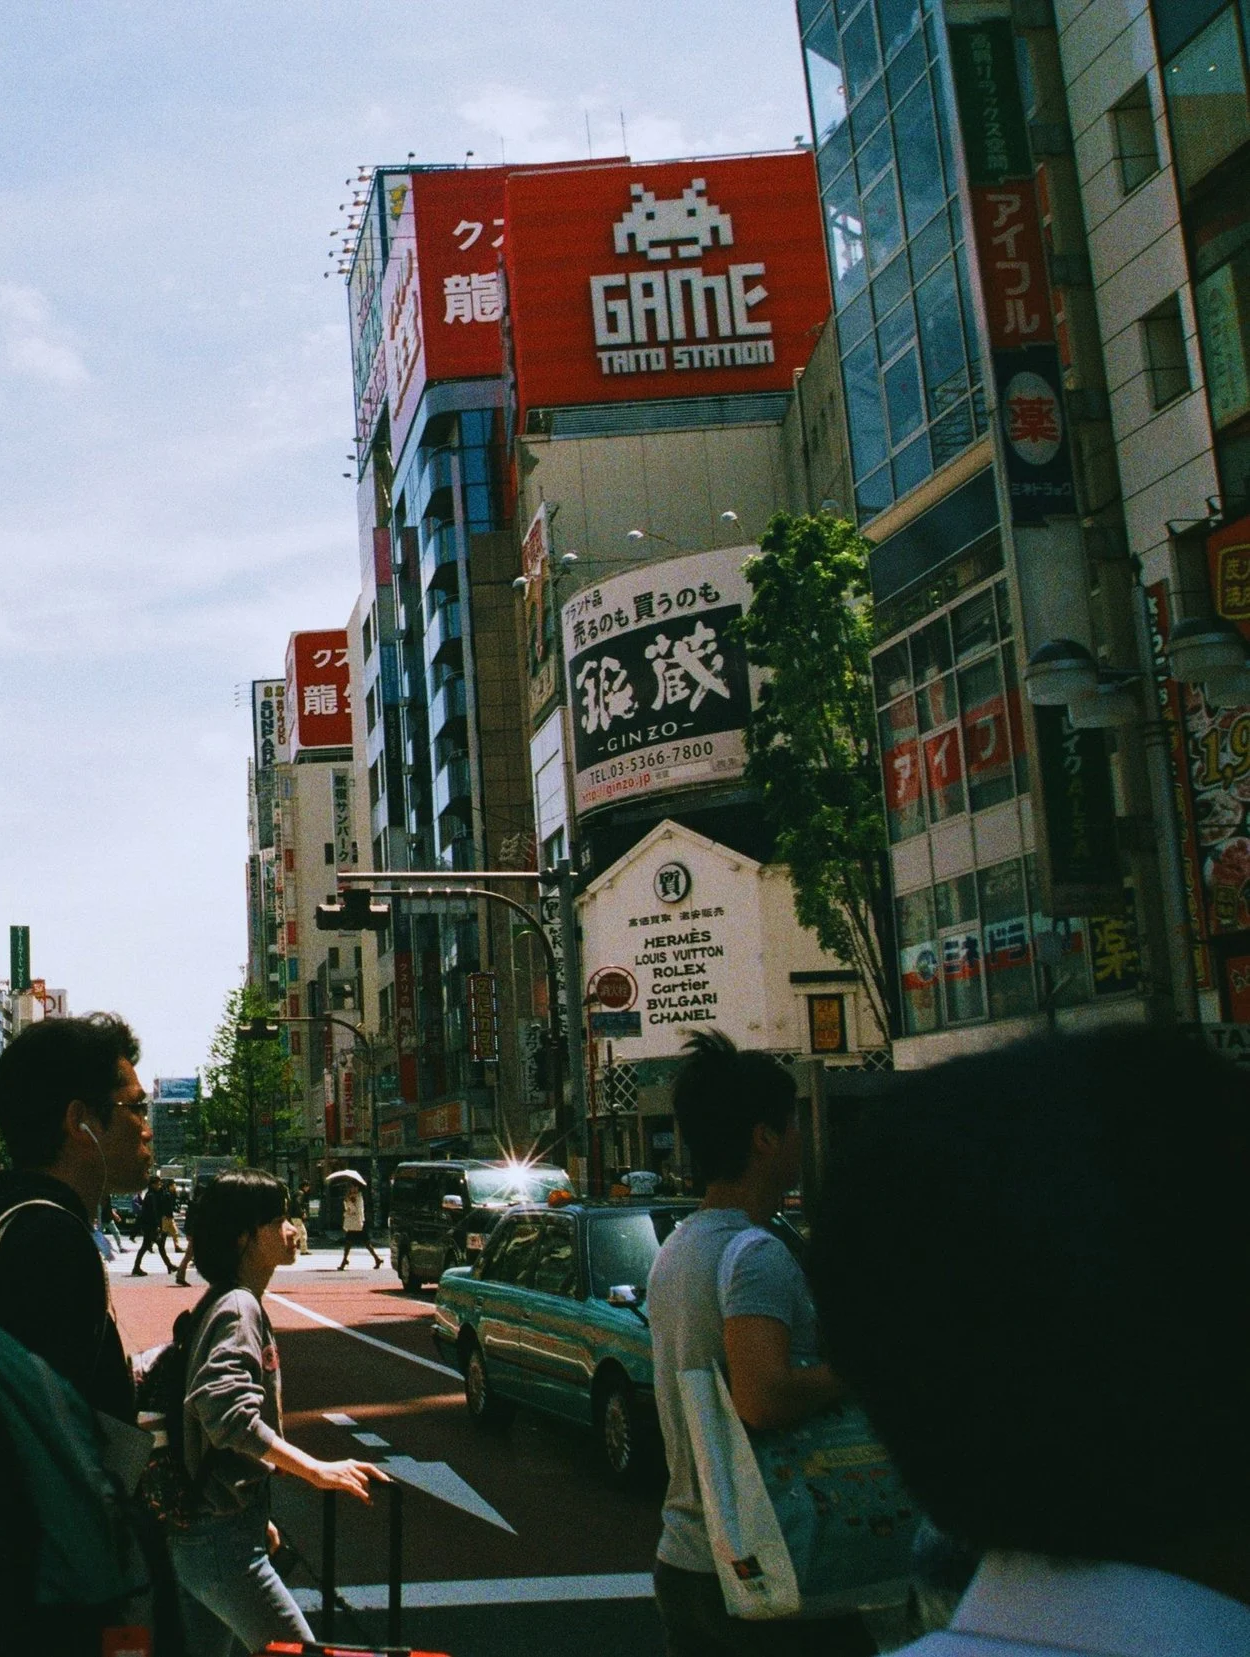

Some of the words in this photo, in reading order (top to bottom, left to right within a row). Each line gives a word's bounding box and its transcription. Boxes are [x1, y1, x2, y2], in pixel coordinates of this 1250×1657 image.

[987, 194, 1040, 334] アイフル
[444, 272, 503, 324] 龍
[590, 263, 772, 347] GAME
[597, 347, 667, 375] TAITO
[674, 340, 775, 371] STATION
[1007, 397, 1060, 442] 薬
[565, 589, 603, 625] ブランド品
[644, 927, 712, 950] HERMÈS
[635, 951, 667, 967] LOUIS
[673, 945, 724, 963] VUITTON
[652, 963, 707, 979] ROLEX
[651, 979, 710, 995] Cartier
[646, 993, 717, 1011] BVLGARI
[649, 1008, 717, 1026] CHANEL
